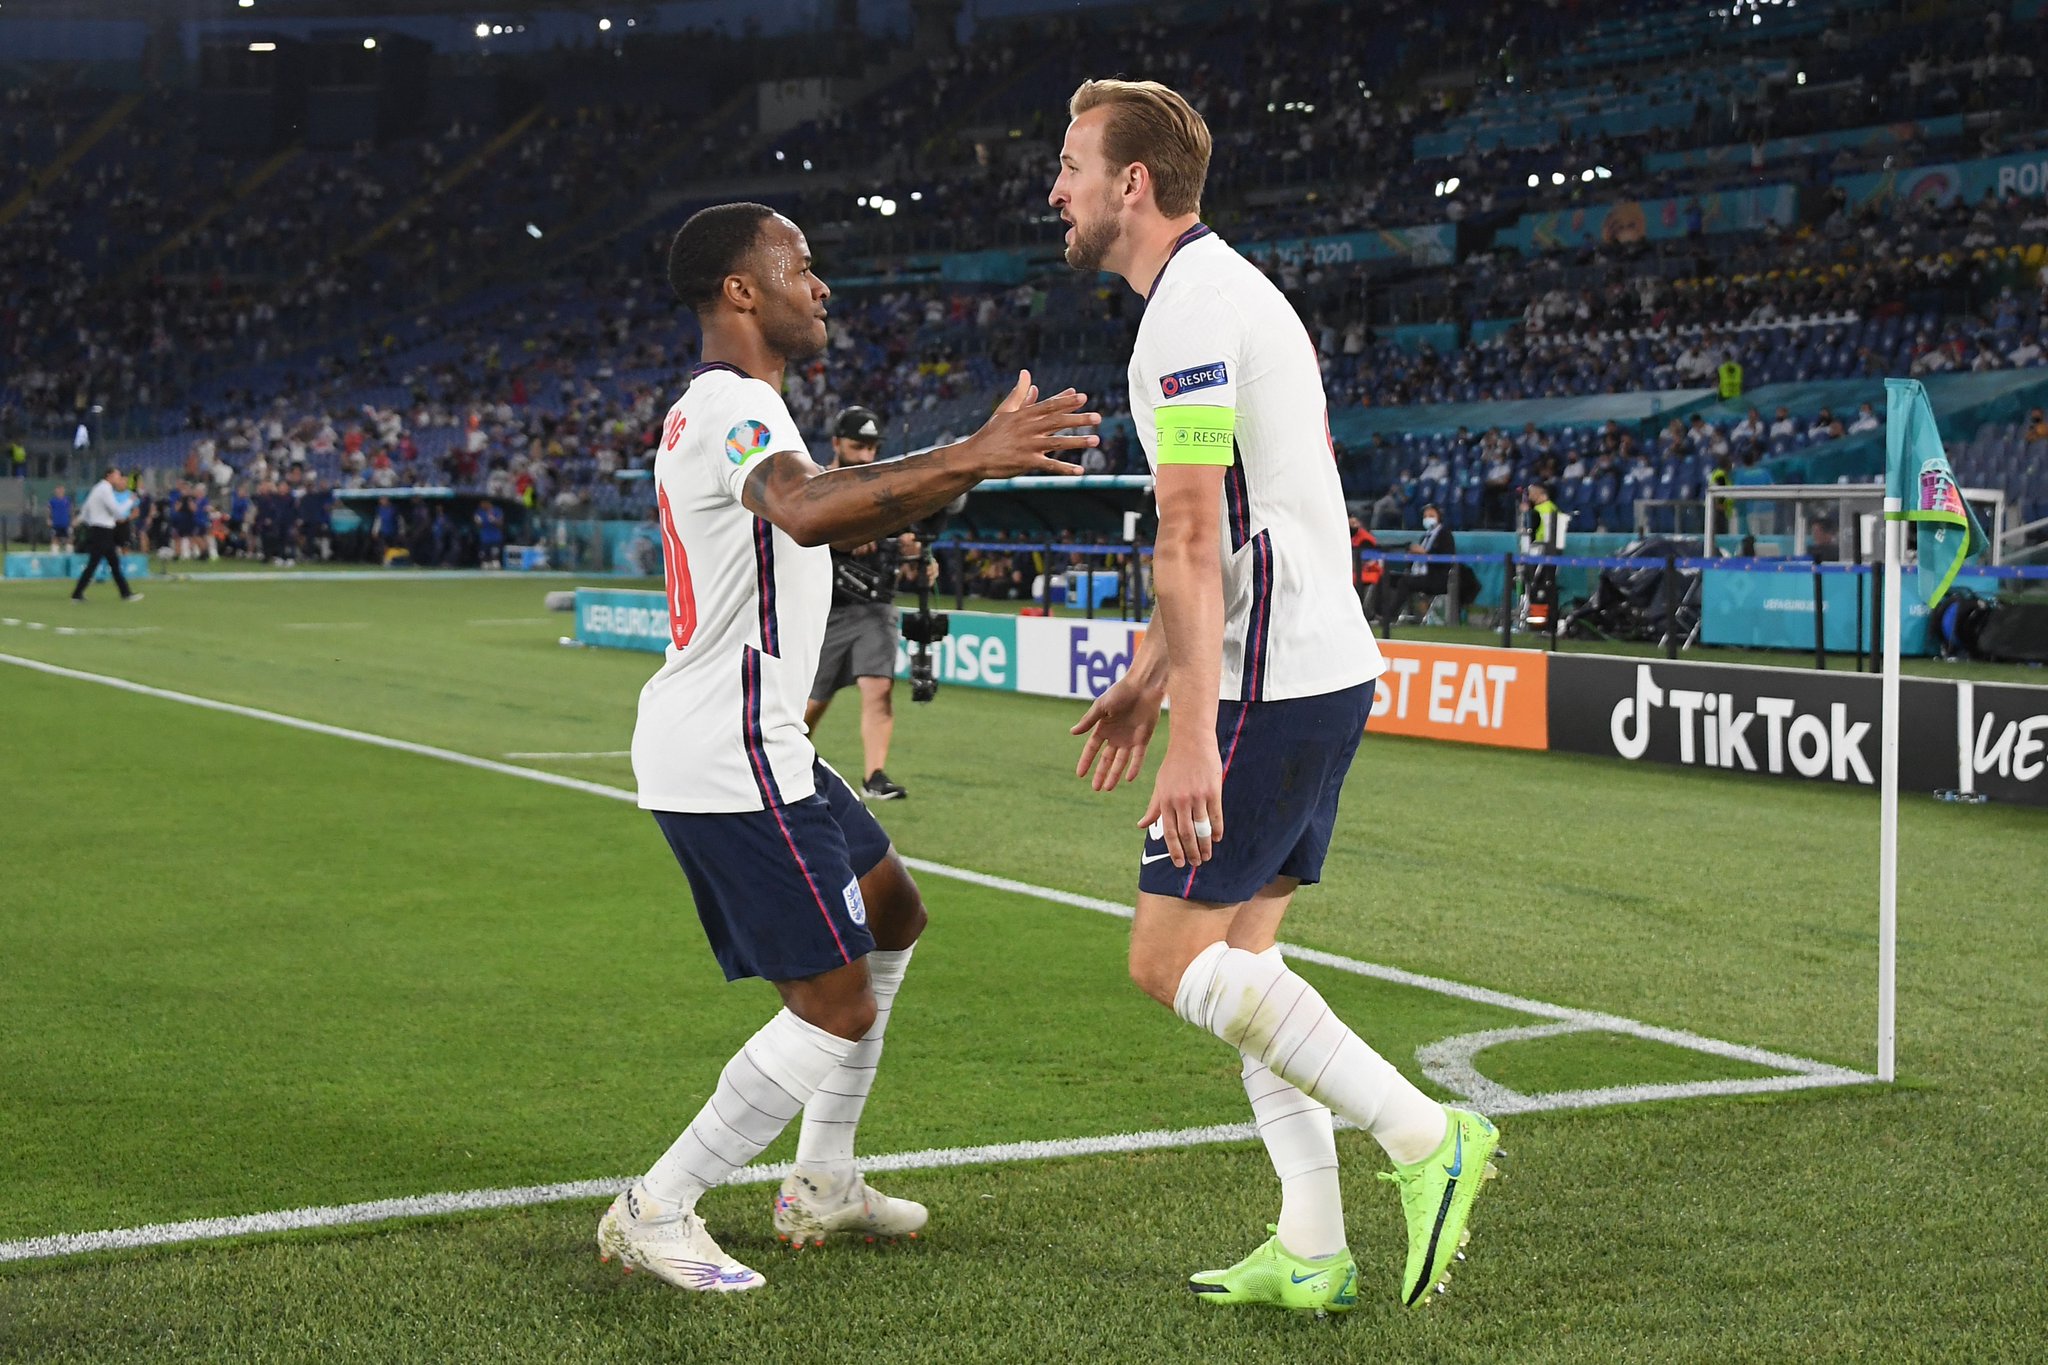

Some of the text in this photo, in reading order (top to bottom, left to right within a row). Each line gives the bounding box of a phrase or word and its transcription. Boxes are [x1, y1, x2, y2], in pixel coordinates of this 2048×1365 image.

[1178, 368, 1226, 388] RESPECT
[1428, 660, 1518, 730] EAT
[1669, 688, 1875, 784] TikTok
